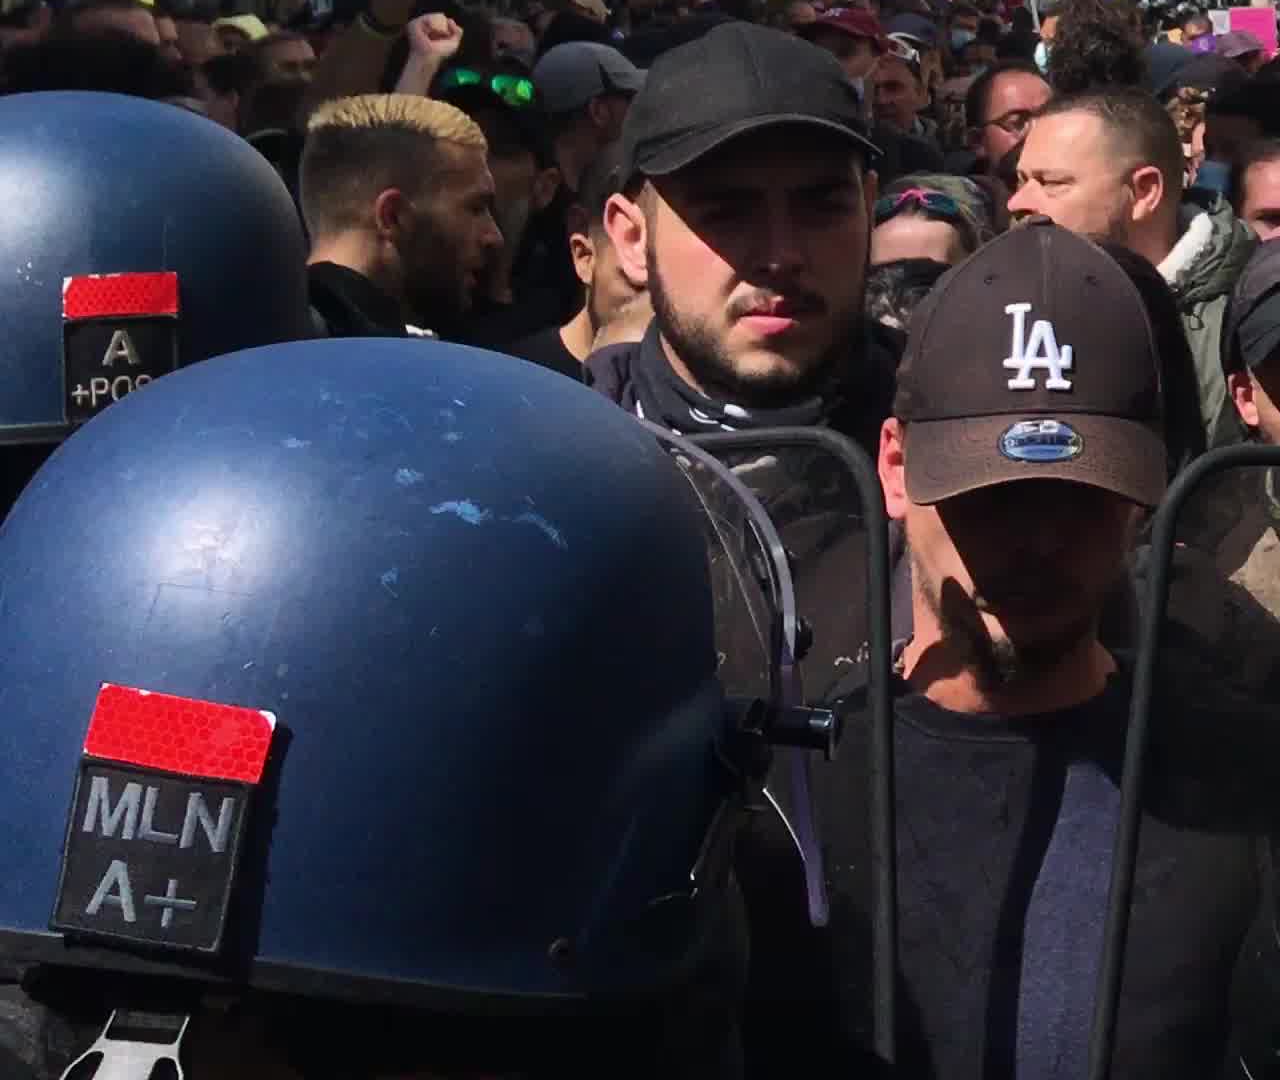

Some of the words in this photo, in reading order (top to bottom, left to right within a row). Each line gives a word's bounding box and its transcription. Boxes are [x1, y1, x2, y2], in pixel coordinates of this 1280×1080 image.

[102, 330, 141, 367] A
[1003, 302, 1073, 390] LA
[82, 776, 236, 853] MLN
[85, 859, 197, 928] A+
